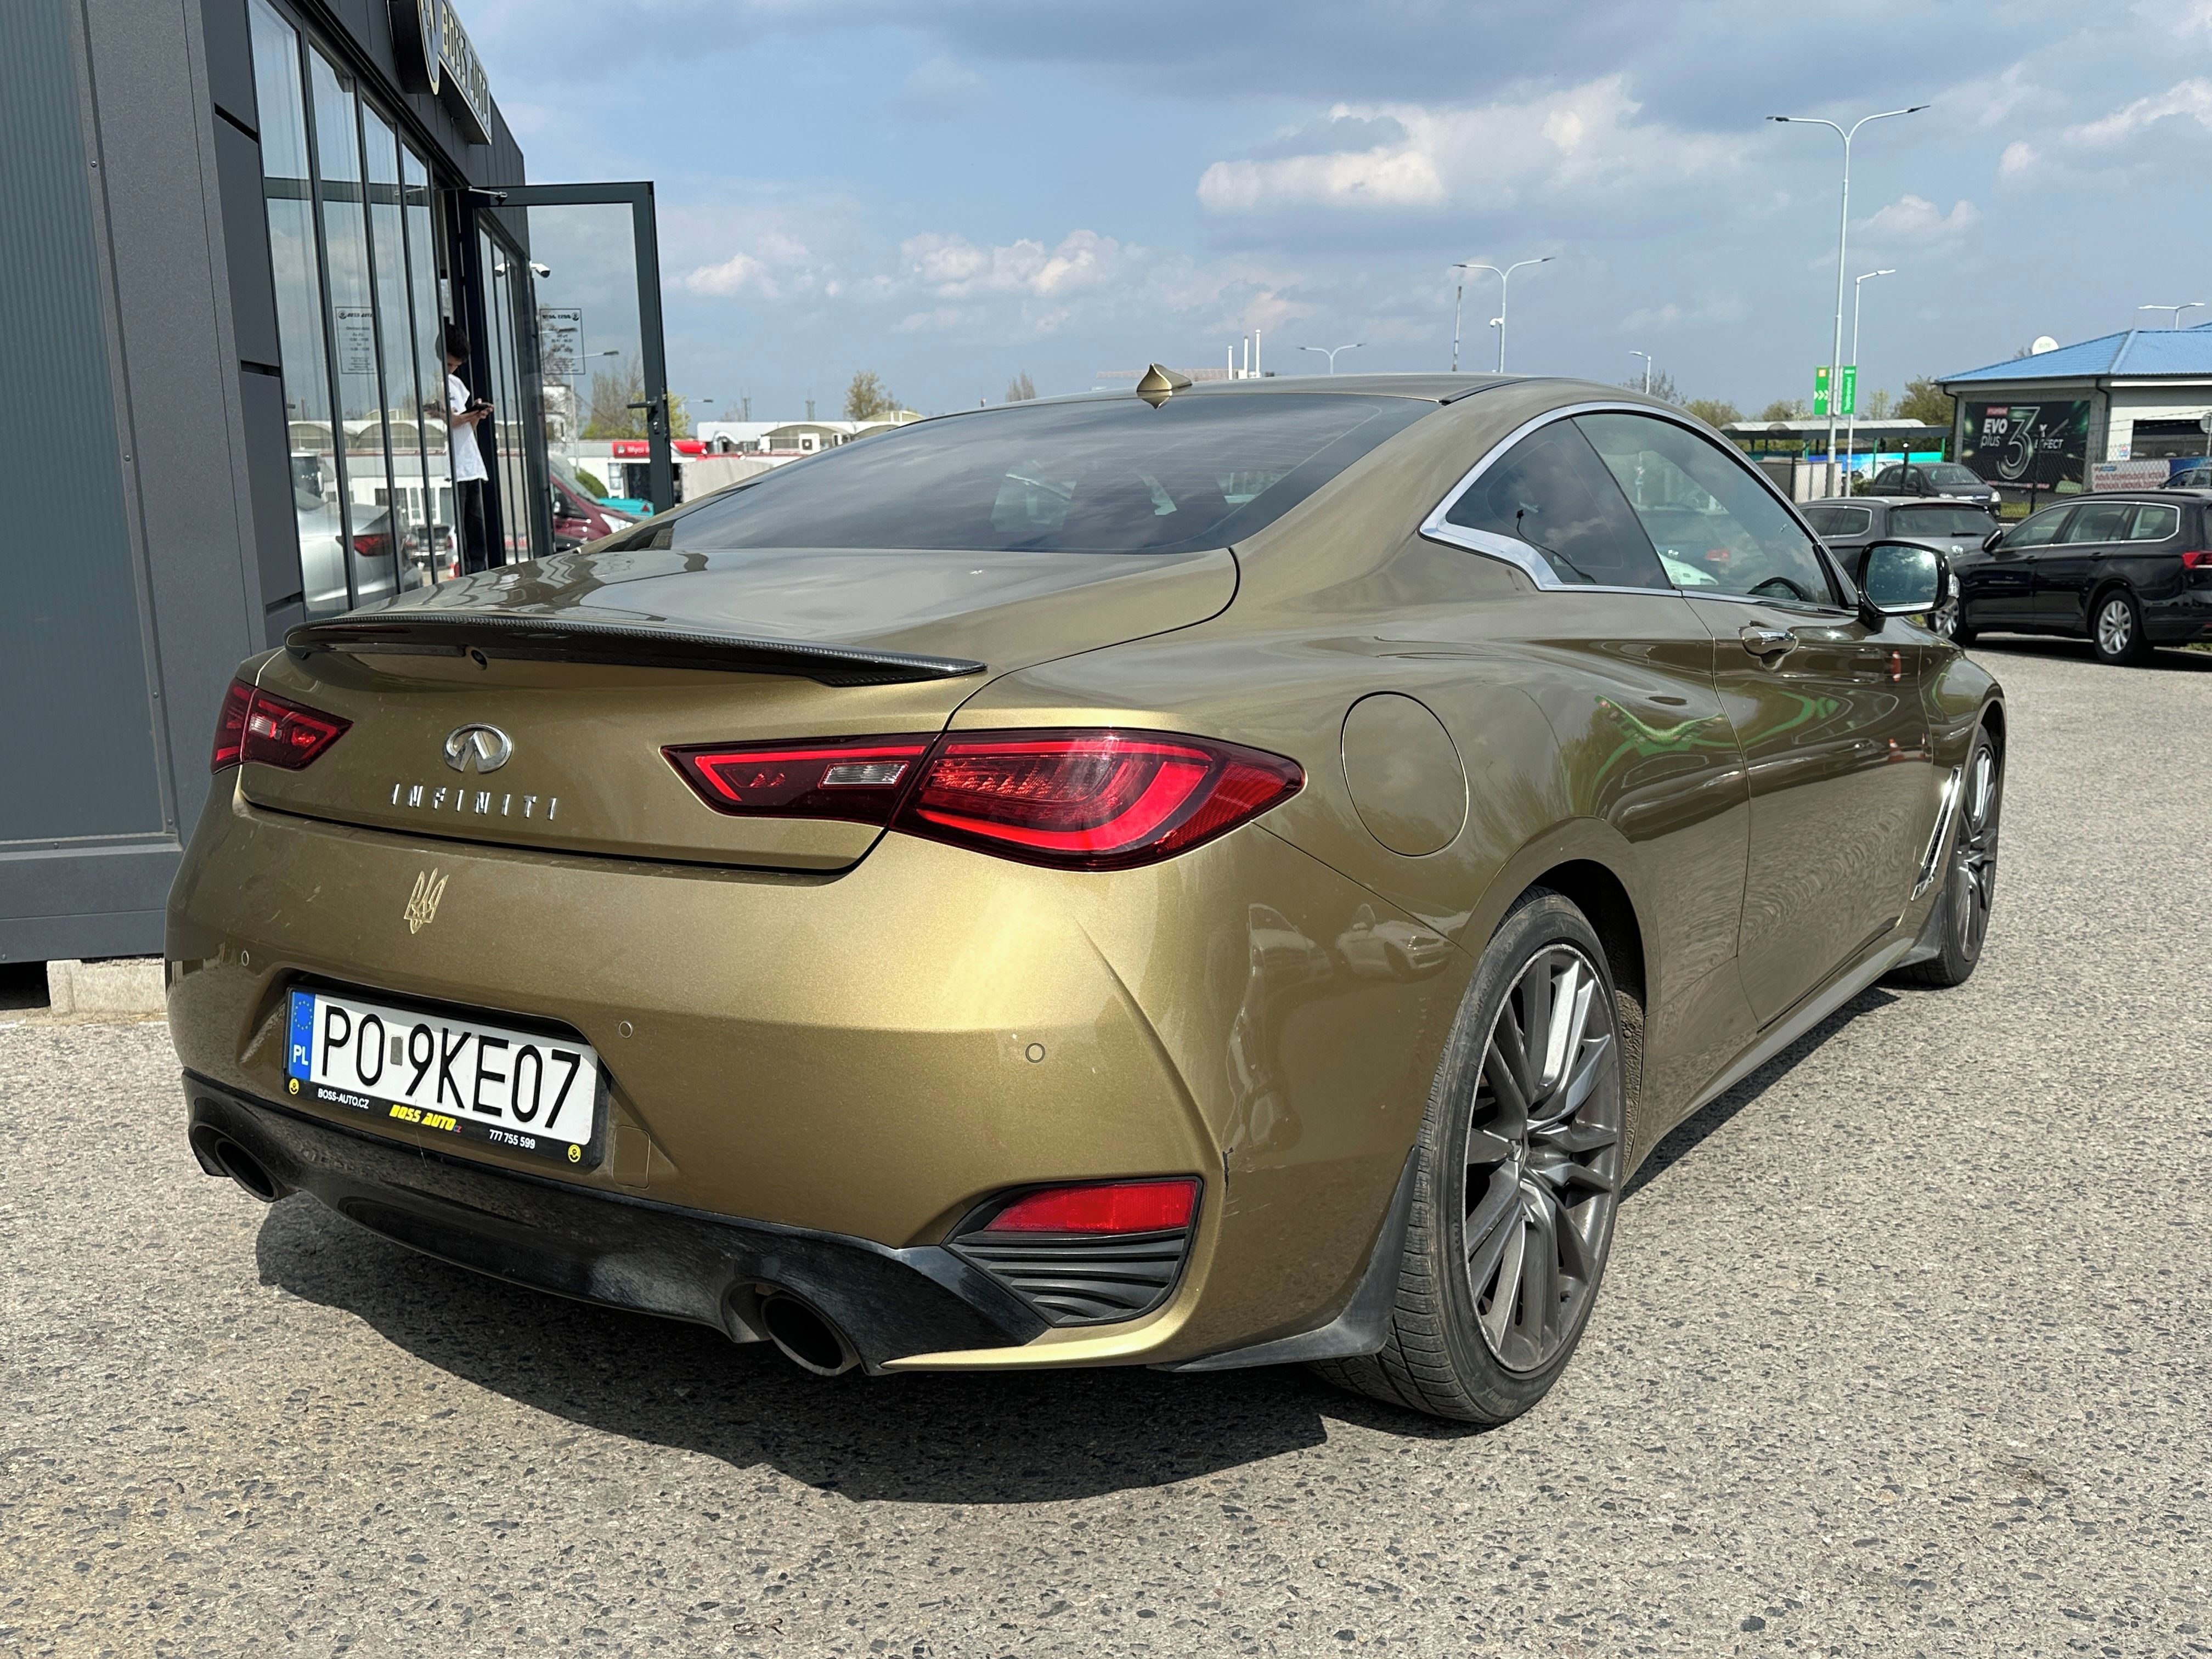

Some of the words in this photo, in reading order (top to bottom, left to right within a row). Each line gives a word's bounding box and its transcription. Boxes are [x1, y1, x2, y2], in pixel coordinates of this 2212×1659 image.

[442, 0, 467, 88] BOSS
[470, 50, 488, 125] AUTO
[1983, 418, 2008, 434] EVO
[1980, 433, 2000, 449] plus
[391, 783, 557, 821] INFINITI
[293, 1044, 308, 1066] PL
[405, 1023, 581, 1128] 9KE07
[317, 1087, 370, 1110] BOSS-AUTO.CZ
[389, 1104, 421, 1122] BOSS
[421, 1111, 457, 1131] AUTO
[489, 1128, 503, 1142] 777
[504, 1133, 518, 1146] 755
[520, 1136, 536, 1149] 599
